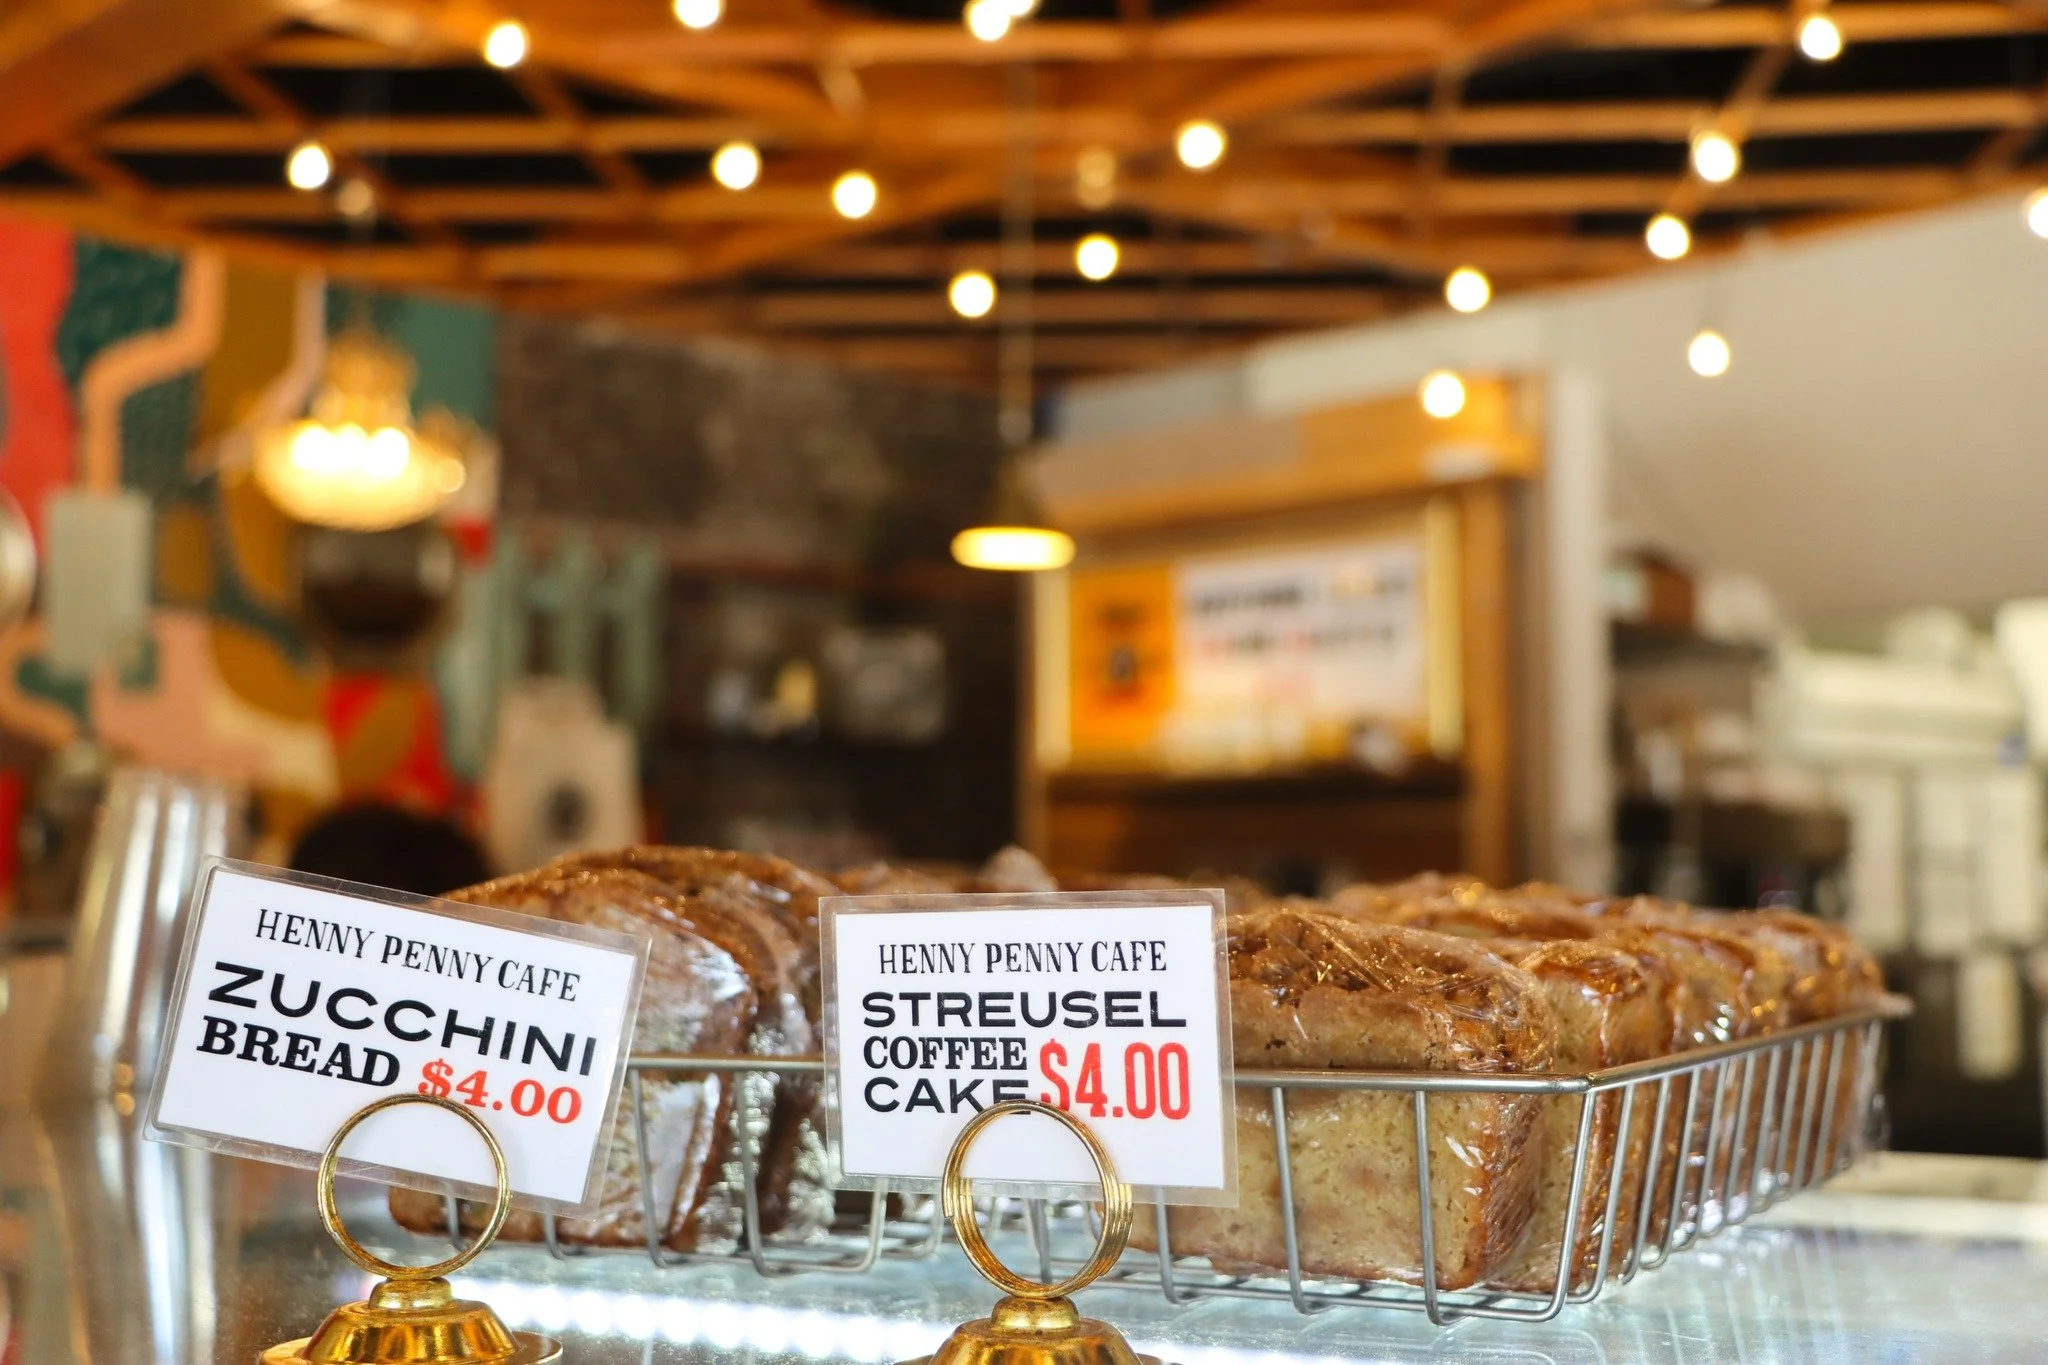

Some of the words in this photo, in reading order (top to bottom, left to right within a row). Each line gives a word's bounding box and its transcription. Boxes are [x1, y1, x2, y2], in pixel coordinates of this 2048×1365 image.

[256, 909, 375, 959] HENNY
[381, 935, 494, 983] PENNY
[497, 959, 581, 1002] CAFE
[879, 943, 975, 974] HENNY
[985, 942, 1083, 973] PENNY
[1091, 940, 1167, 971] CAFE
[208, 961, 597, 1076] ZUCCHINI
[862, 990, 1186, 1028] STREUSEL
[196, 1016, 400, 1087] BREAD
[417, 1058, 582, 1124] $4.00
[863, 1036, 1027, 1070] COFFEE
[864, 1076, 1030, 1114] CAKE
[1039, 1038, 1190, 1120] $4.00
